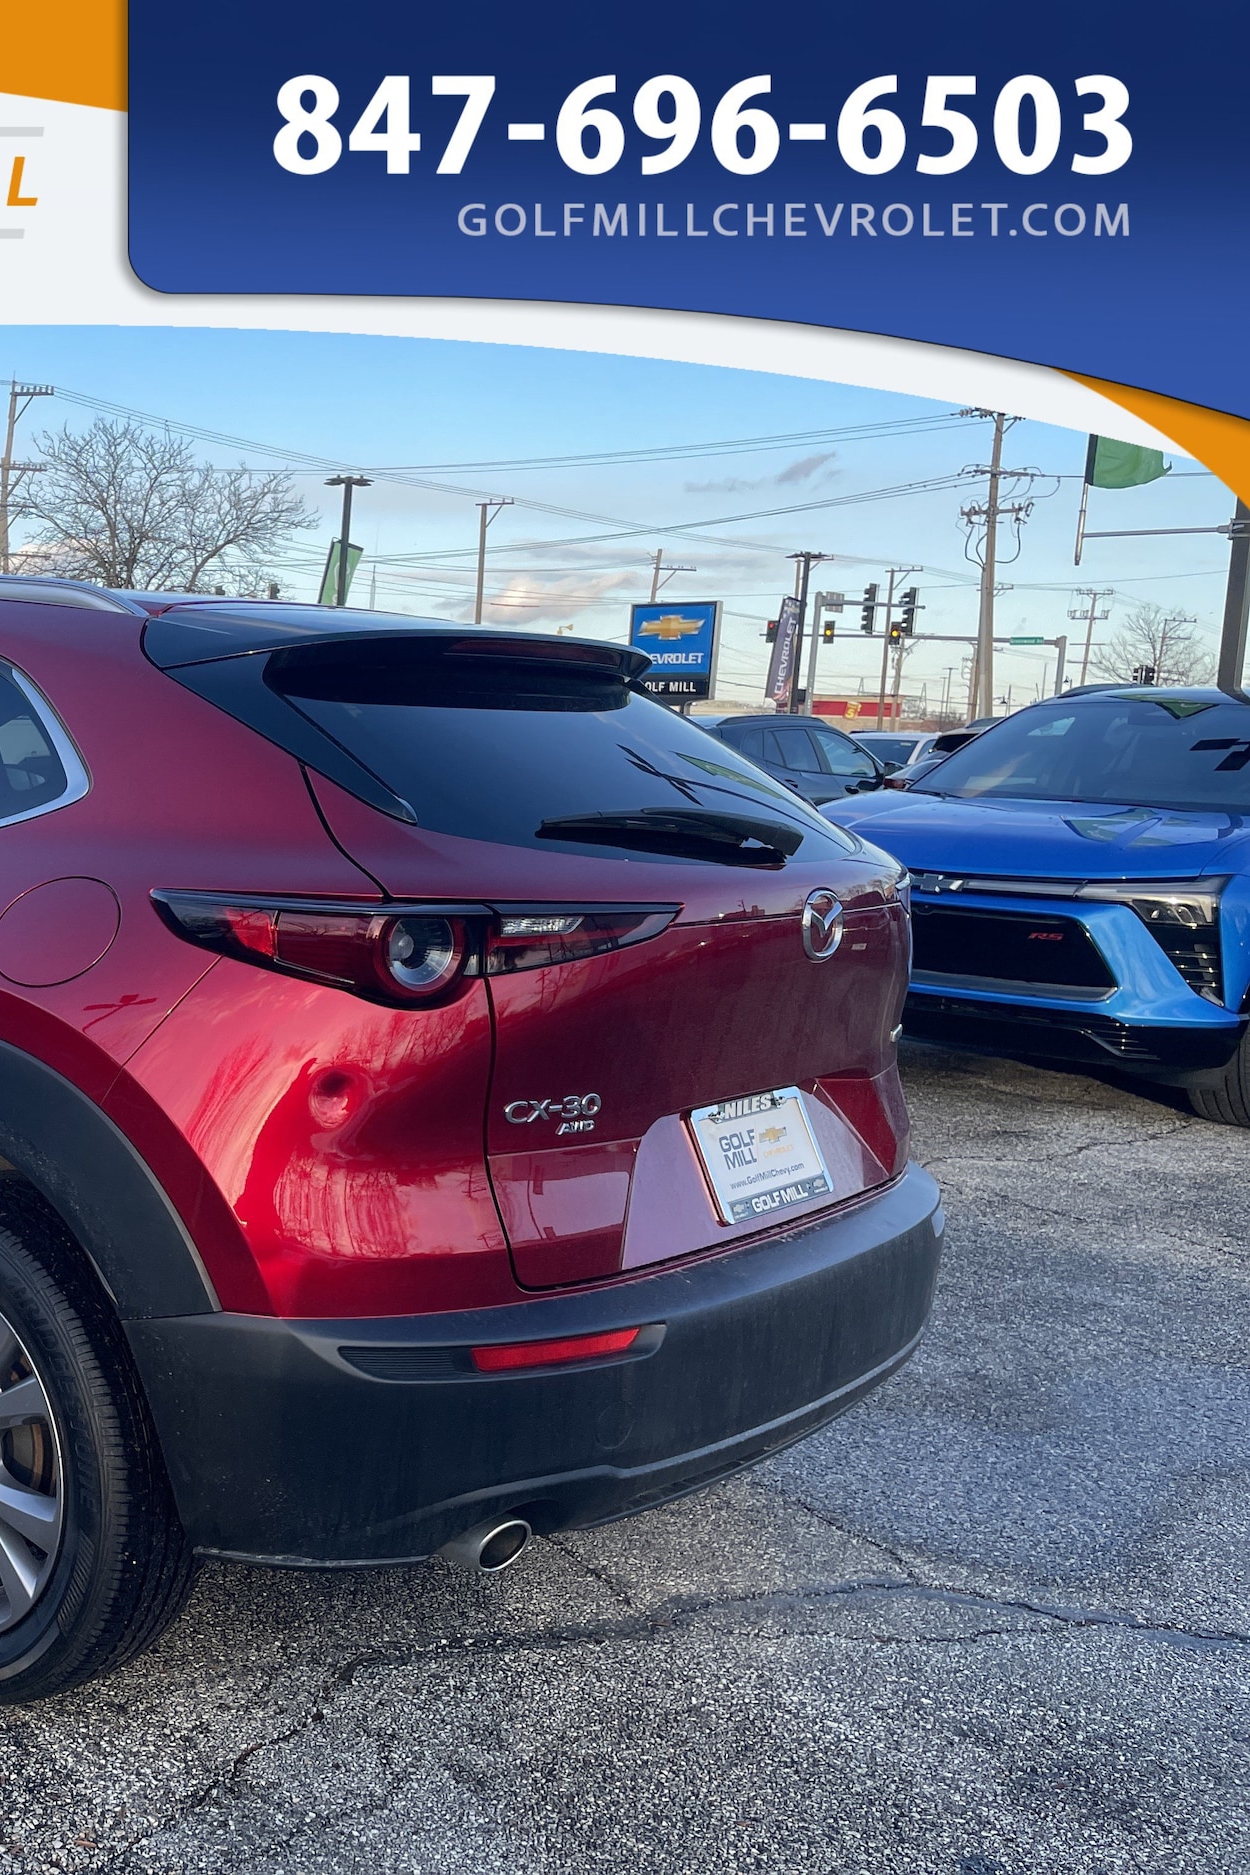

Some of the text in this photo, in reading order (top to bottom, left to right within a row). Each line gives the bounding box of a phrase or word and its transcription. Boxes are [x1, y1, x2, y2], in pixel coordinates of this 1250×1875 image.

[651, 652, 704, 664] EVROLET
[774, 616, 797, 695] CHEVROLET
[644, 681, 696, 693] OLF MILL
[503, 1093, 602, 1124] CX-30
[724, 1093, 772, 1119] NILES
[555, 1120, 595, 1136] AWD
[718, 1129, 755, 1153] GOLF
[723, 1148, 757, 1170] MILL
[751, 1184, 809, 1213] GOLF MILL
